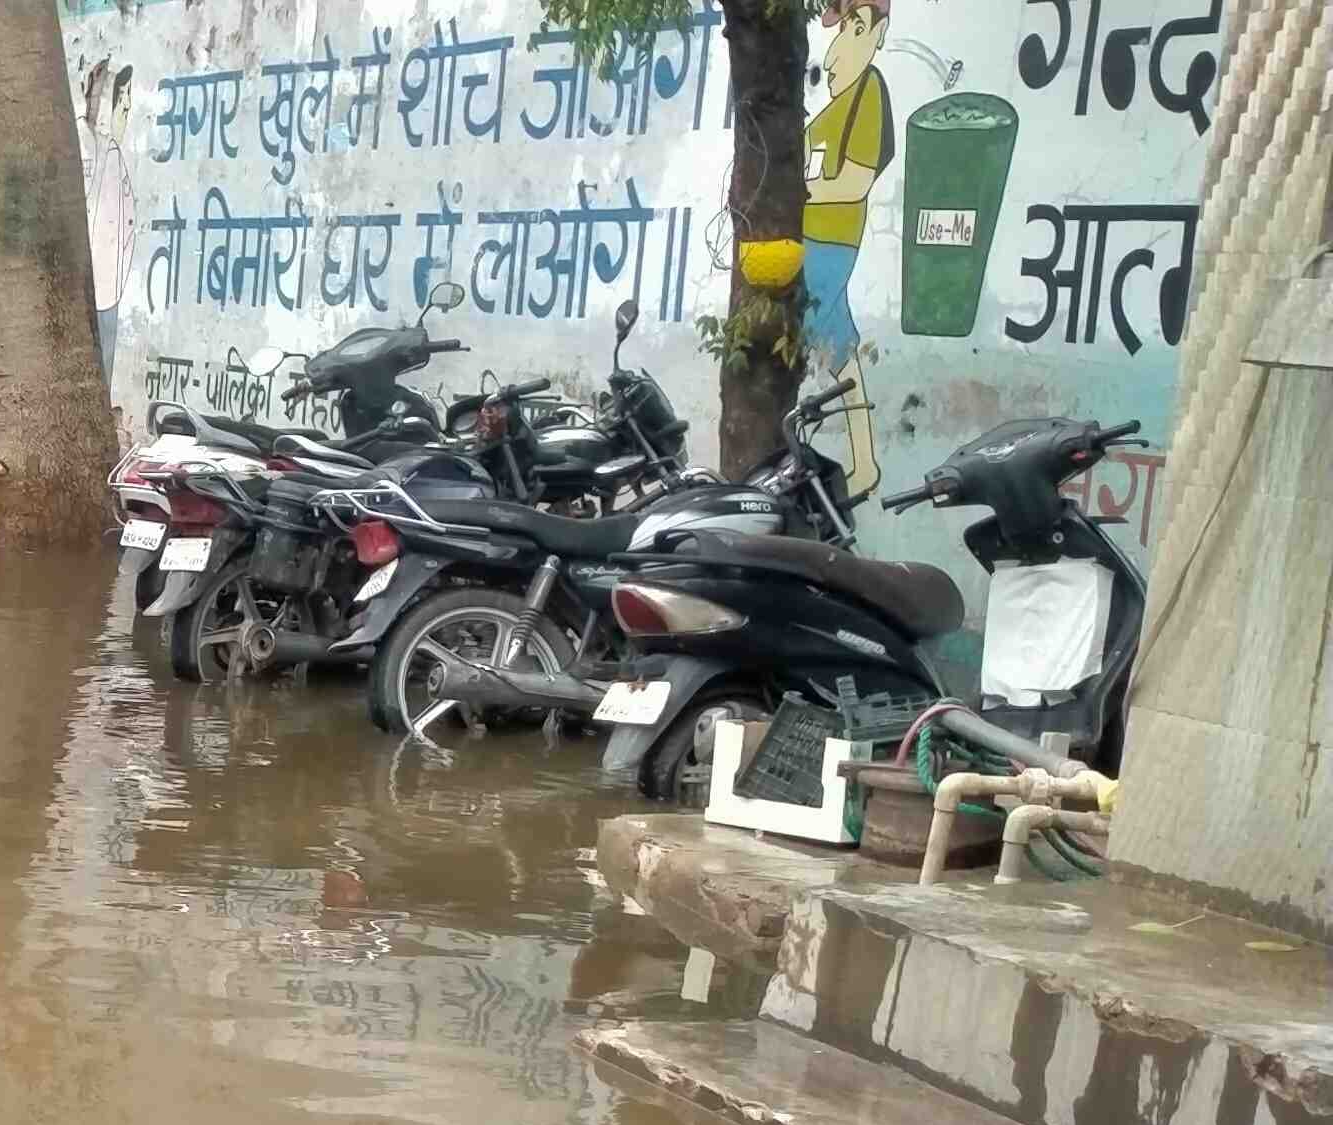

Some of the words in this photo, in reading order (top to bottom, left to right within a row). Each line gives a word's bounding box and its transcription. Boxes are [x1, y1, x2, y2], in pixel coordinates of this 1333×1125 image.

[151, 70, 244, 163] अगर
[259, 34, 340, 186] खुले
[347, 26, 392, 150] में
[397, 17, 515, 147] शौच
[146, 194, 187, 315] तो
[196, 186, 314, 313] बिमारी
[320, 213, 402, 313] घर
[412, 179, 464, 310] में
[919, 211, 972, 242] Use-Me
[740, 501, 772, 513] Hero
